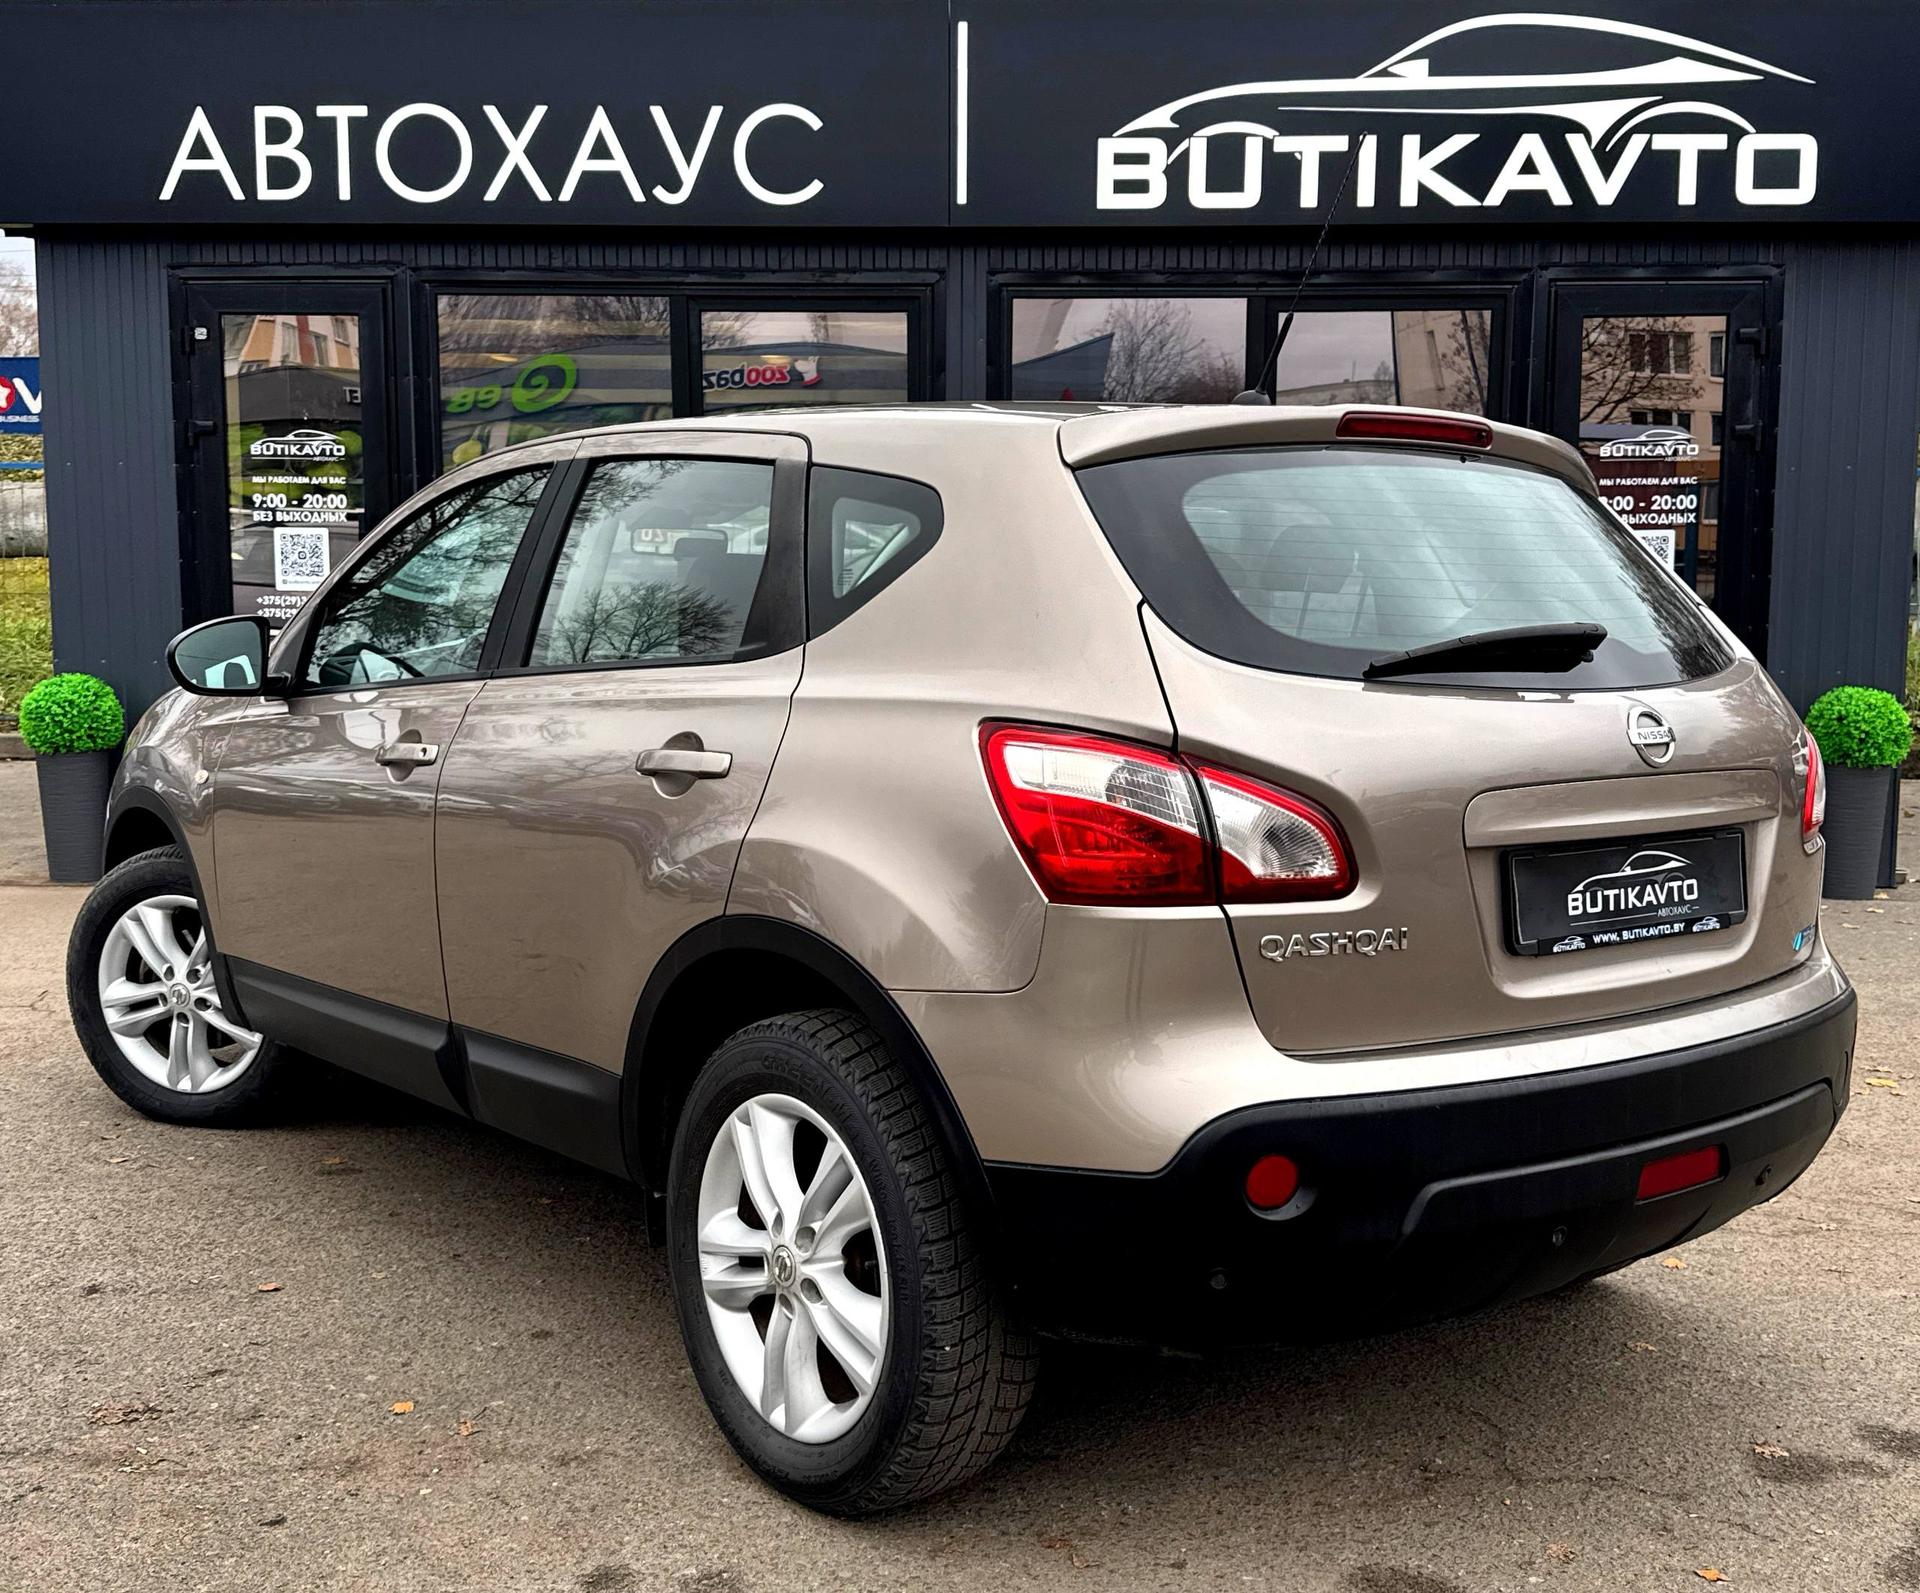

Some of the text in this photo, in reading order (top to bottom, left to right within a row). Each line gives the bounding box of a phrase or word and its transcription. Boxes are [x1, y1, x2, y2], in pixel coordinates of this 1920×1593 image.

[159, 102, 824, 206] АВТОХАУС
[1096, 133, 1819, 210] BUTIKAVTO
[250, 443, 346, 456] BUTIKAVTO
[1600, 444, 1699, 457] BUTIKAVTO
[268, 476, 310, 484] РАБОТАЕМ
[311, 477, 328, 485] ДЛЯ
[1599, 476, 1698, 487] МЫ РАБОТАЕМ ДЛЯ ВАС
[252, 494, 287, 509] 9:00
[302, 494, 348, 509] 20:00
[1650, 494, 1698, 510] 20:00
[253, 510, 348, 522] БЕЗ ВЫХОДНЫХ
[1637, 730, 1673, 740] NISSA
[1567, 878, 1698, 916] BUTIKAVTO
[1260, 926, 1408, 962] QASHQAI
